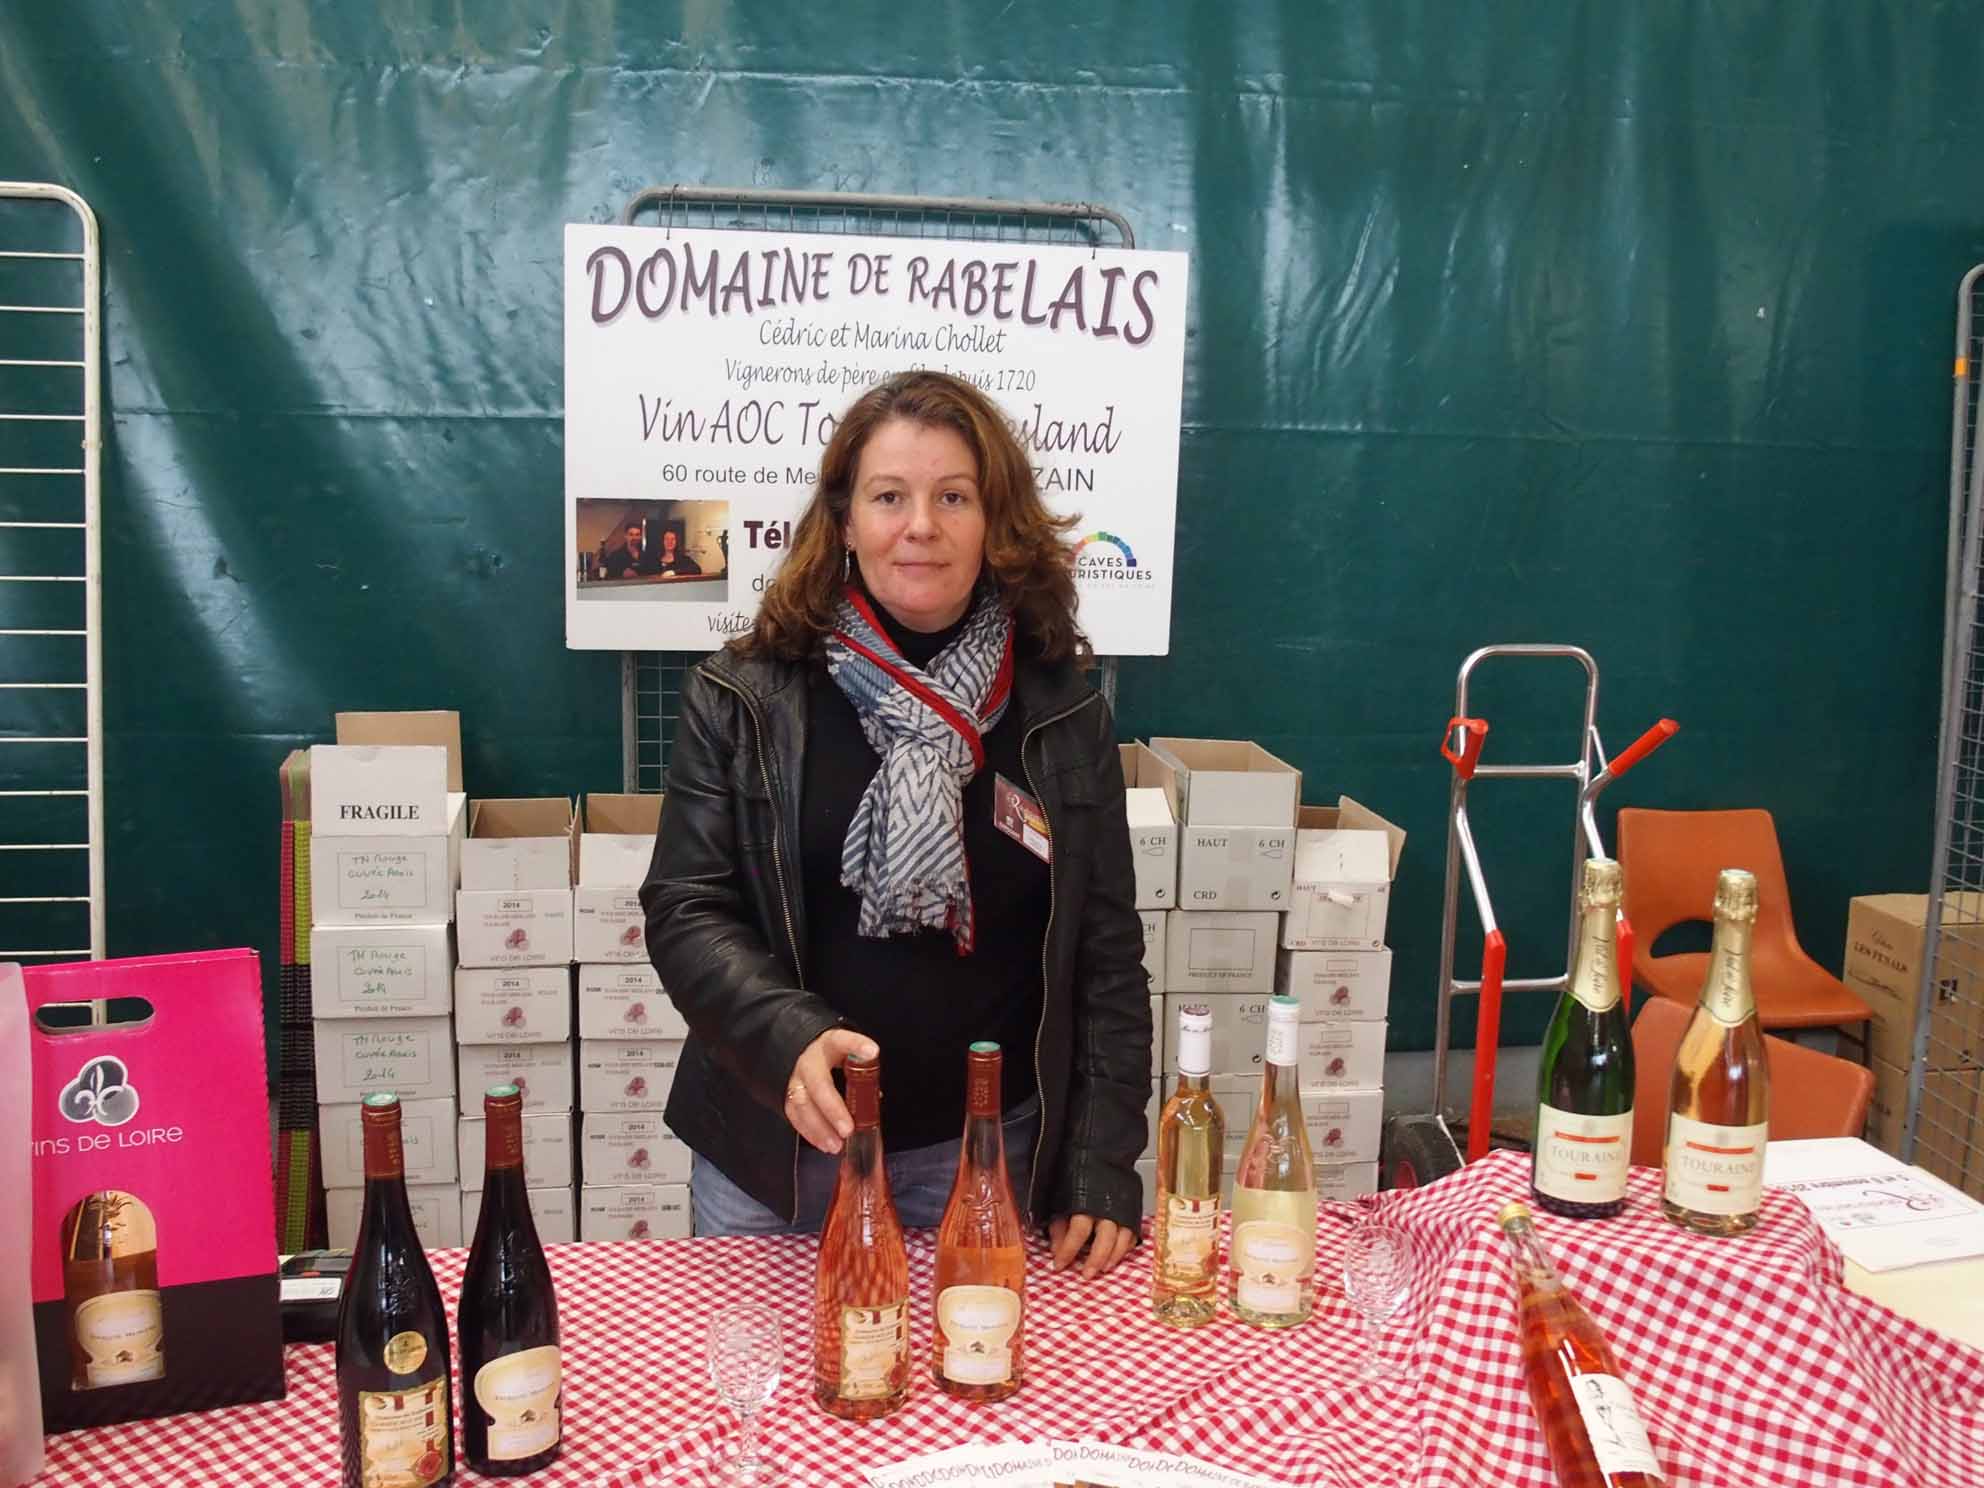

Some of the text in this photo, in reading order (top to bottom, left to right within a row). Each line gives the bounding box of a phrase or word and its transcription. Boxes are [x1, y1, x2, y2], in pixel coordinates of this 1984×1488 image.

[586, 242, 1158, 346] DOMAINE DE RABELAIS
[759, 319, 1007, 353] Cédric et Marina Chollet
[725, 358, 812, 389] Vignerons
[816, 361, 837, 384] de
[841, 363, 879, 392] père
[996, 369, 1036, 392] 1720
[639, 393, 1123, 455] Vin AOC To sland
[662, 464, 1095, 492] 60 route de Me ZAIN
[1078, 556, 1123, 568] CAVES
[707, 610, 756, 634] visite
[340, 804, 420, 821] FRAGILE
[1140, 837, 1166, 846] 6 CH
[1197, 838, 1228, 848] HAUT
[1258, 839, 1285, 848] 6 CH
[1193, 891, 1217, 900] CRD
[503, 901, 520, 909] 2014
[1240, 1004, 1246, 1013] 6
[33, 1137, 70, 1156] ins
